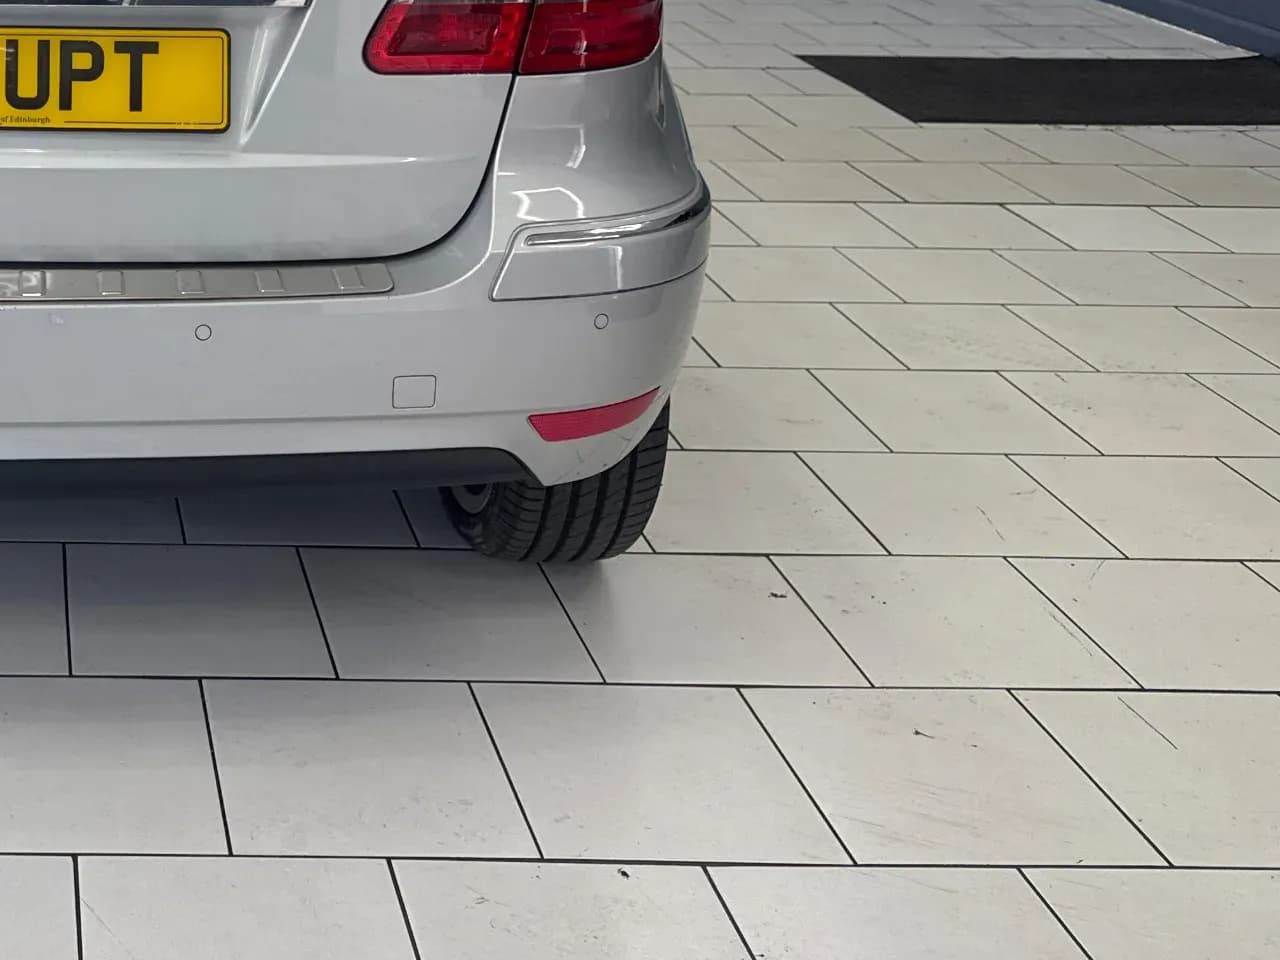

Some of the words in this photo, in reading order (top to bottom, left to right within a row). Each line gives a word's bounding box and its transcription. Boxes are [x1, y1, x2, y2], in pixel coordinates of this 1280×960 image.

[5, 39, 160, 112] UPT
[0, 115, 9, 123] of
[10, 116, 51, 124] Edinburgh
